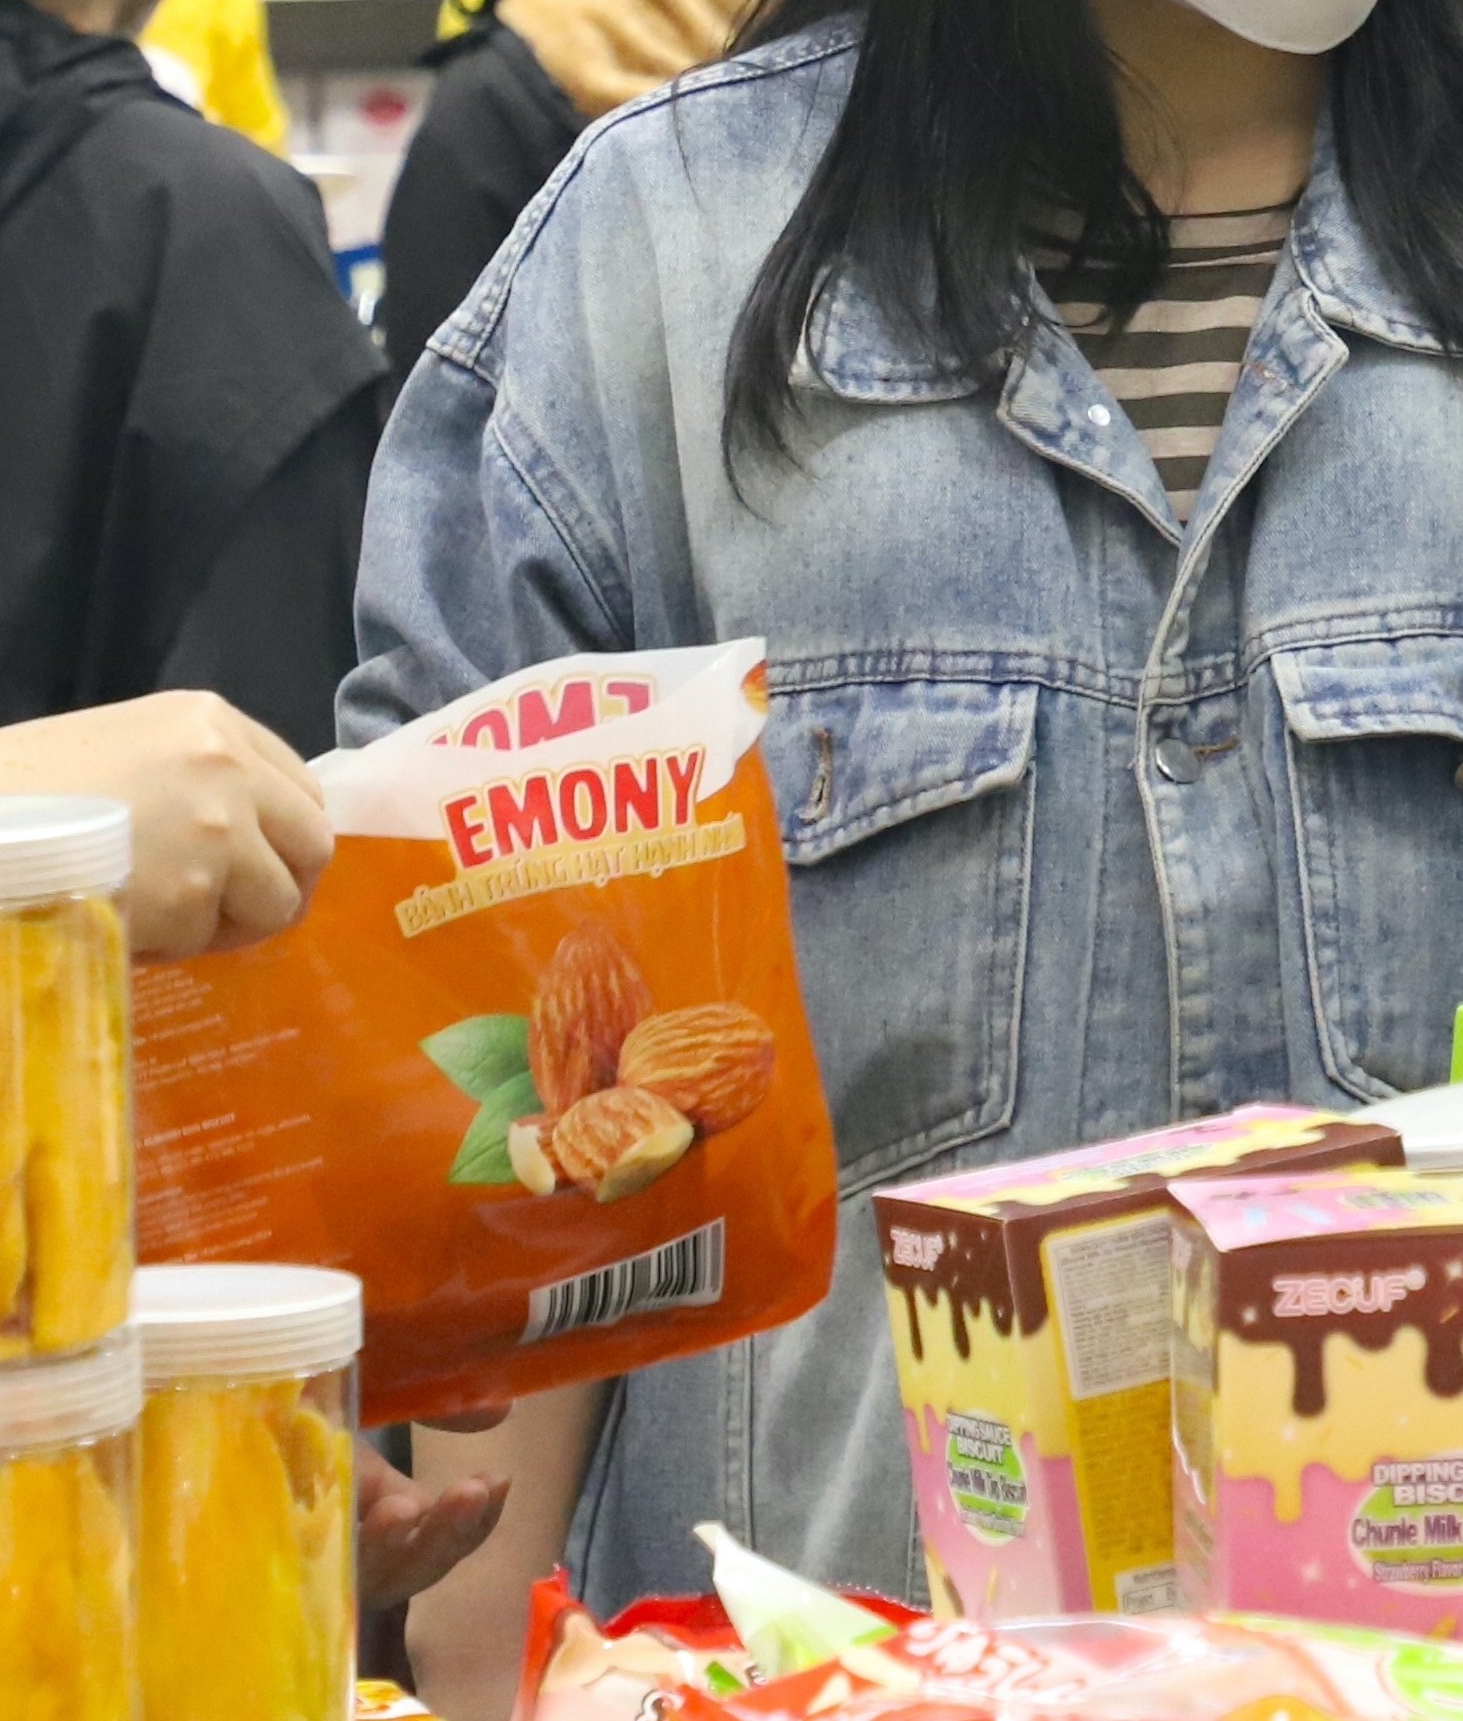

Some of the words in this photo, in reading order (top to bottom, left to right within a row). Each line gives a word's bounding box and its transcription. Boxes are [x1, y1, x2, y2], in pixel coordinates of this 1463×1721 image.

[444, 749, 701, 869] EMONY
[402, 885, 475, 930] BÁNH
[575, 847, 627, 886] HẠT
[1273, 1274, 1409, 1318] ZECUF
[1423, 1512, 1463, 1544] Milk
